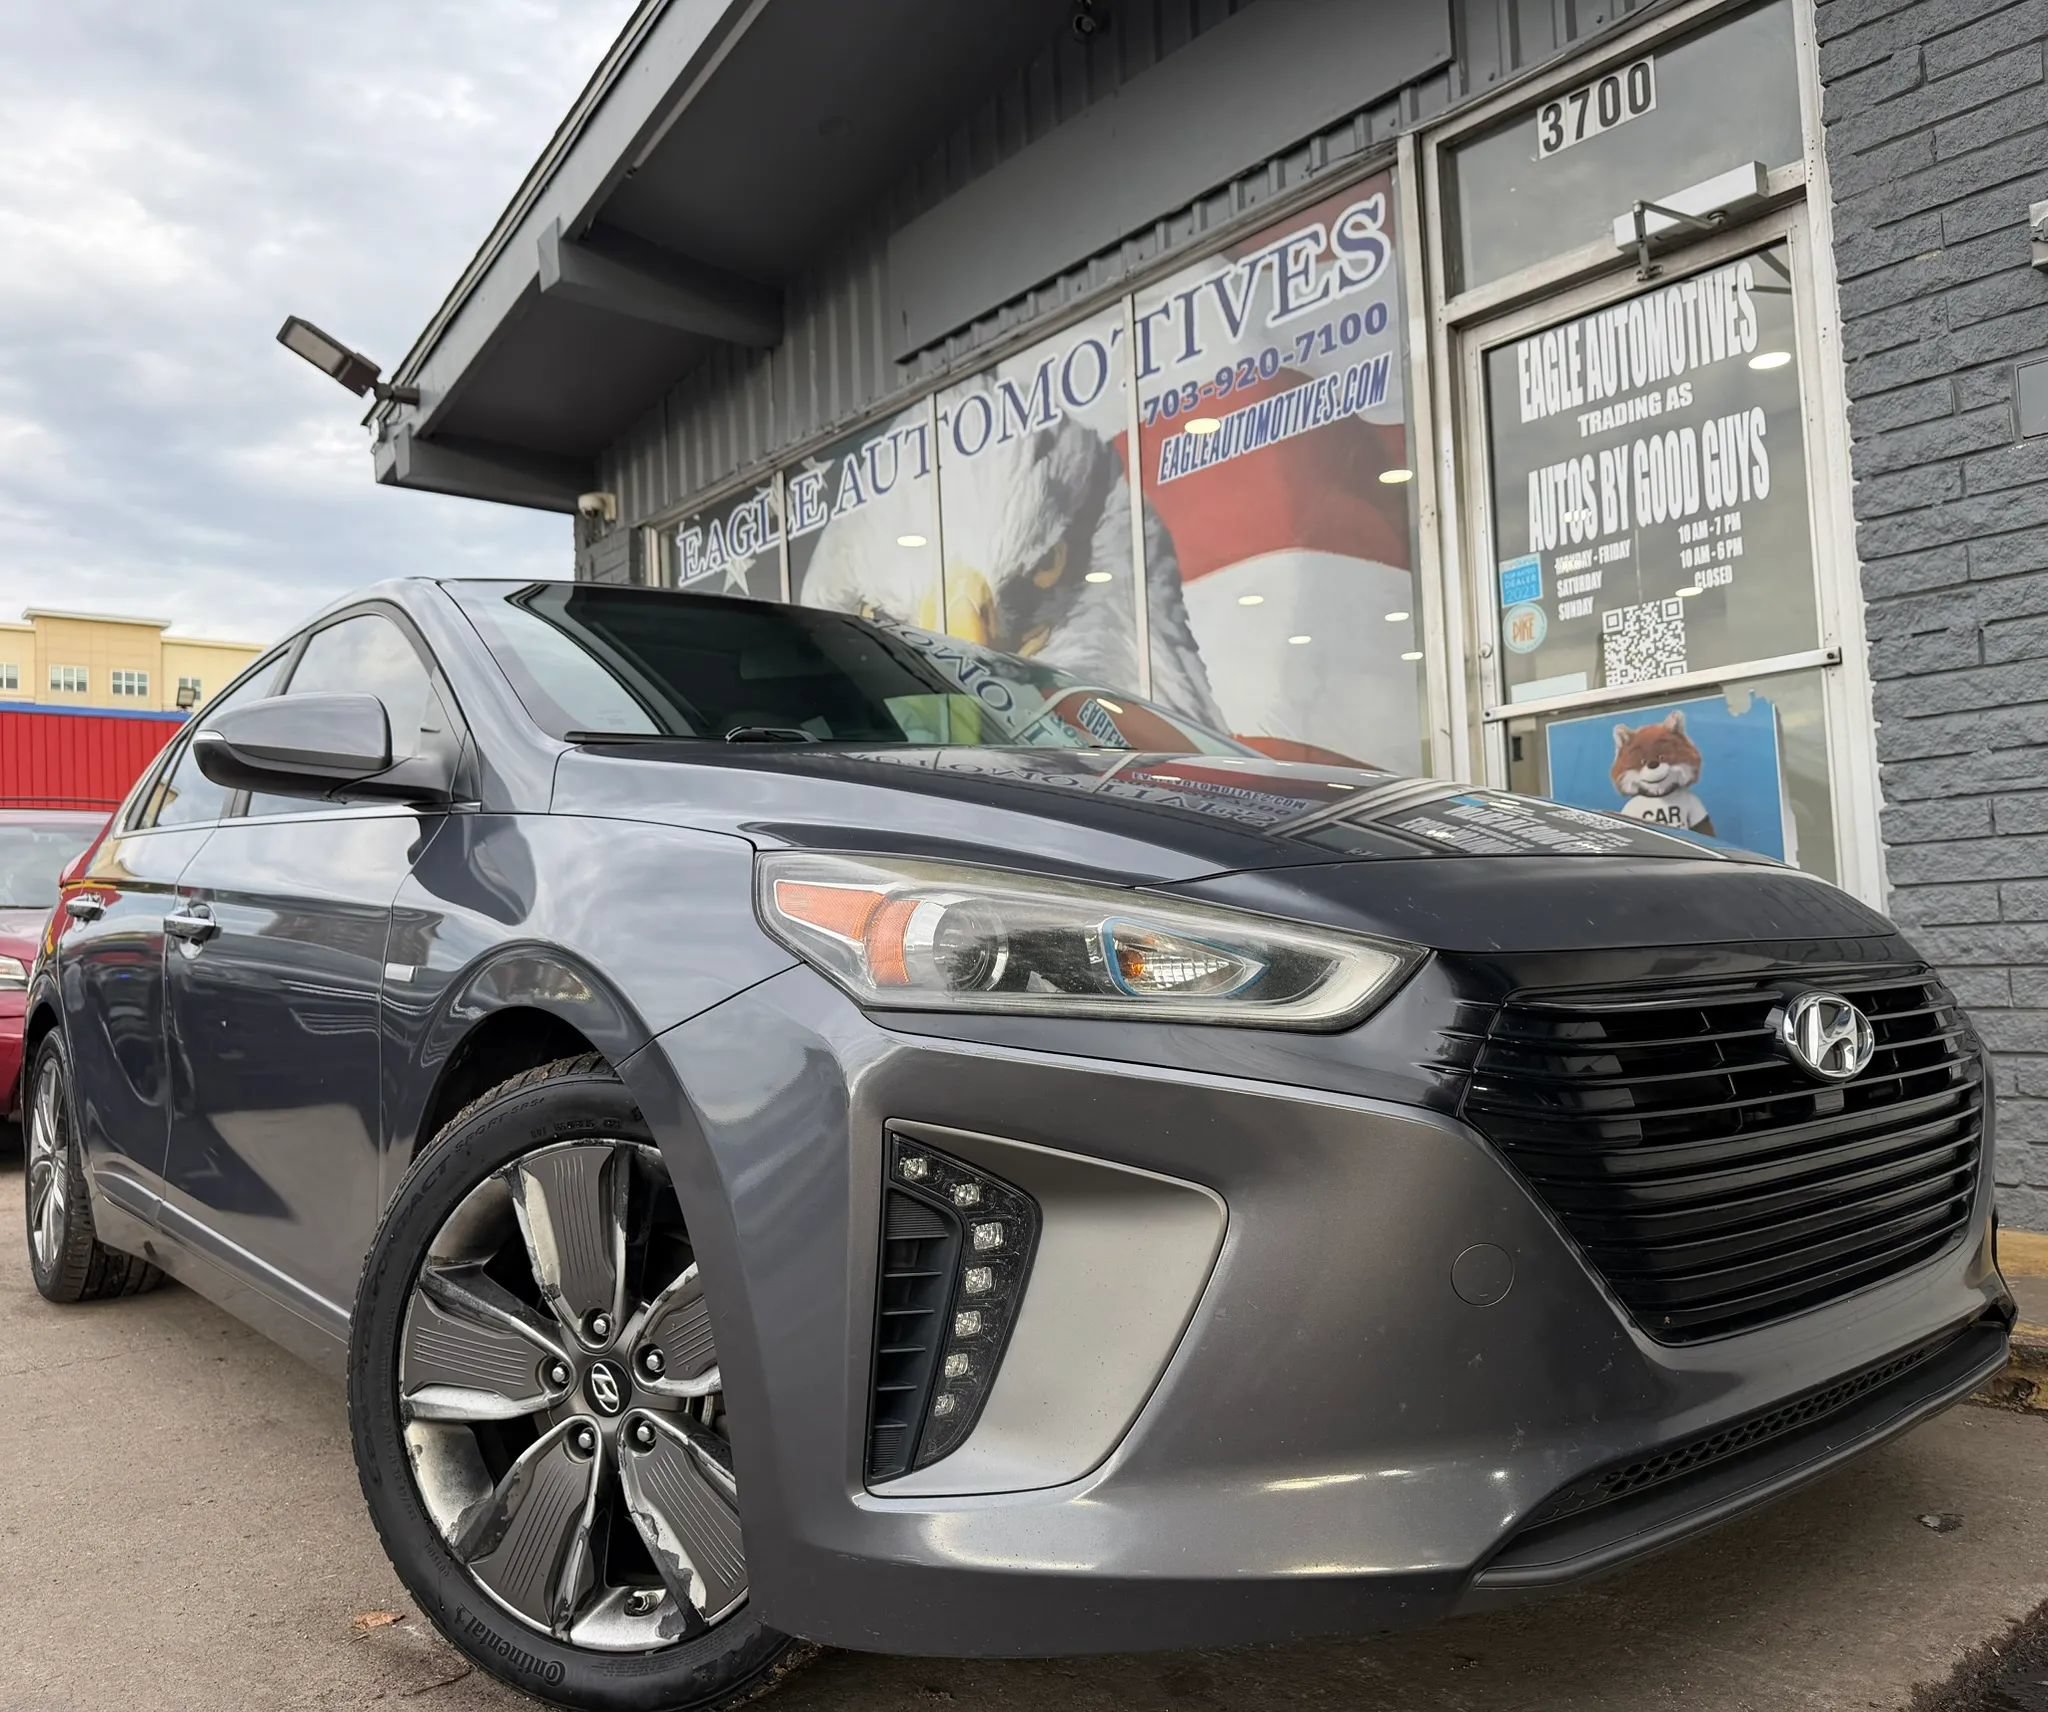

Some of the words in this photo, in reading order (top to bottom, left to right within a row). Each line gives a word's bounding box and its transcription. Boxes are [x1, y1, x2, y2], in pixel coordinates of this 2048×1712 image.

[1542, 62, 1652, 152] 3700
[1143, 302, 1388, 426] 703-920-7100
[1517, 323, 1584, 424] EAGLE
[1585, 261, 1759, 402] AUTOMOTIVES
[676, 468, 829, 588] EAGLE
[831, 192, 1391, 518] AUTOMOTIVES
[1577, 391, 1662, 437] TRADING
[1665, 382, 1694, 412] AS
[1157, 350, 1393, 485] EAGLEAUTOMOTIVES.COM
[1528, 453, 1599, 553] AUTOS
[1600, 444, 1630, 535] BY
[1633, 427, 1700, 528] GOOD
[1701, 406, 1771, 511] GUYS
[1678, 524, 1692, 544] 10
[1692, 519, 1708, 541] AM
[1714, 516, 1722, 535] 7
[1724, 511, 1742, 533] PM
[1598, 539, 1631, 564] FRIDAY
[1680, 548, 1693, 568] 10
[1693, 544, 1711, 566] AM
[1716, 541, 1725, 560] 6
[1725, 536, 1744, 558] PM
[1504, 573, 1538, 589] DEALER
[1505, 585, 1538, 601] 2021
[1556, 570, 1602, 598] SATURDAY
[1694, 564, 1733, 589] CLOSED
[1558, 596, 1594, 621] SUNDAY
[463, 1614, 567, 1688] Continental
